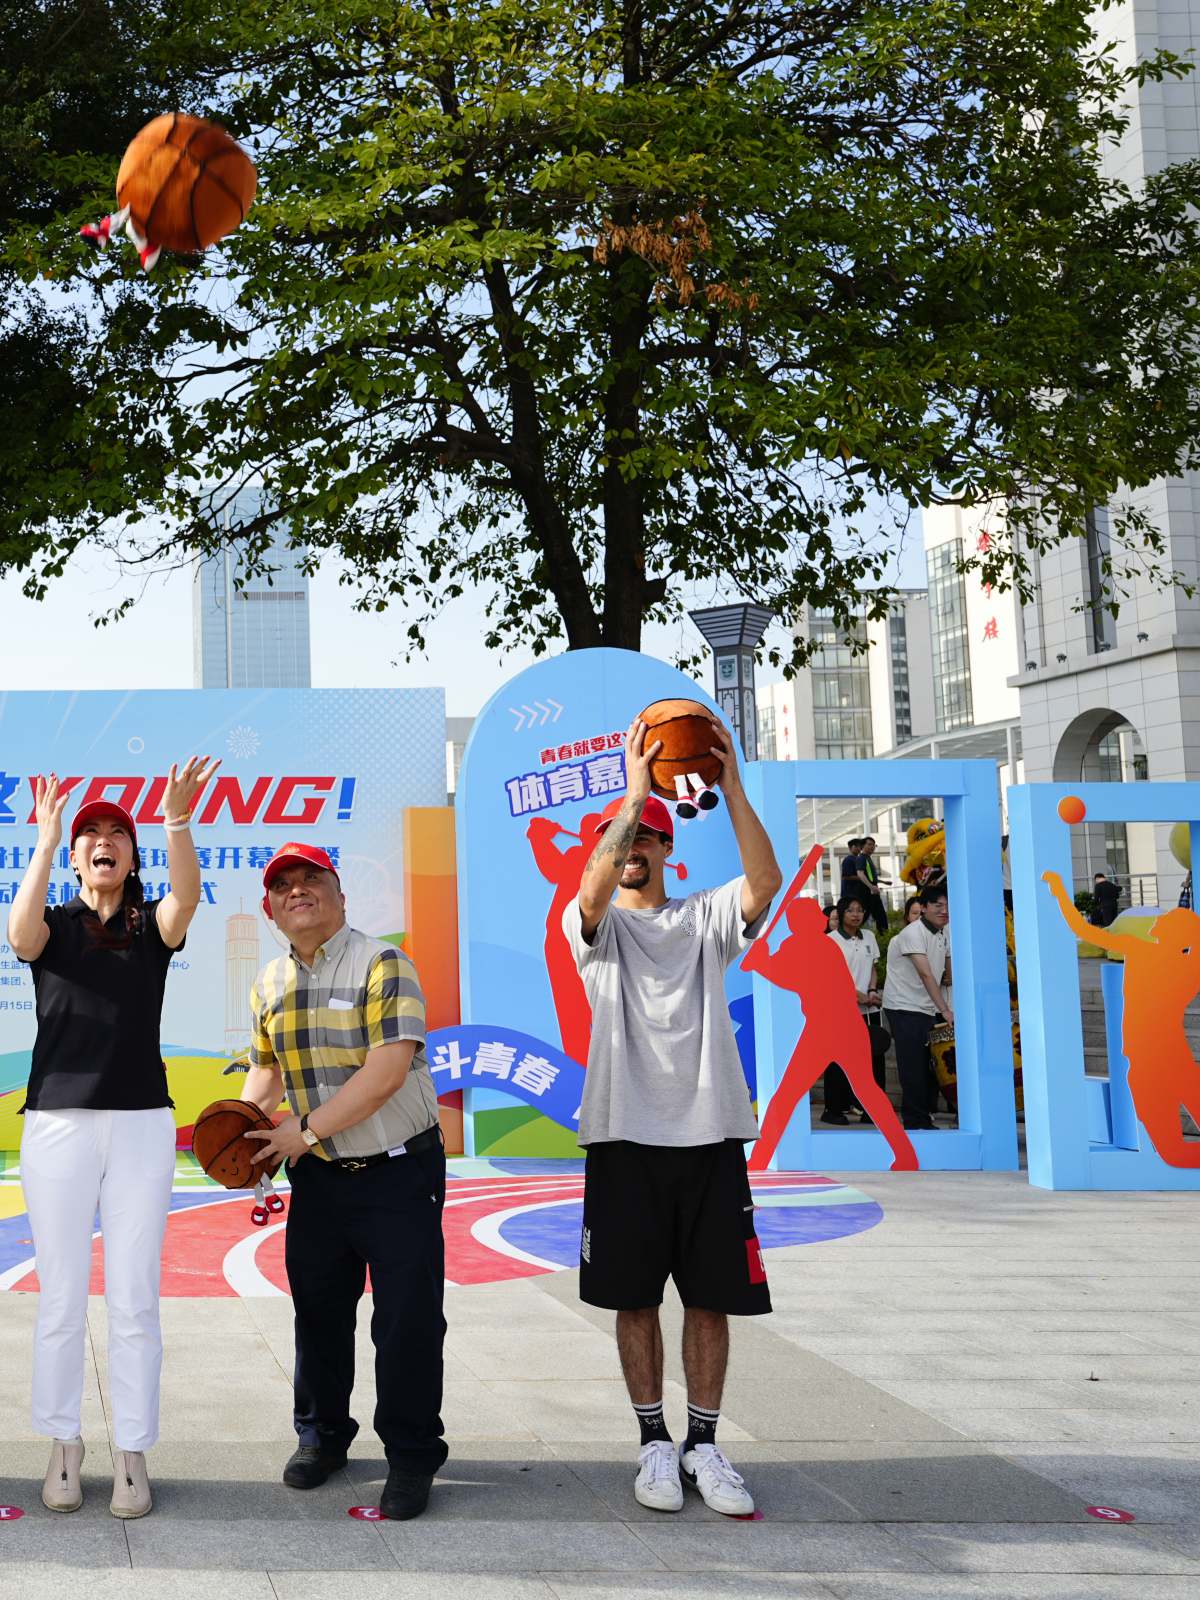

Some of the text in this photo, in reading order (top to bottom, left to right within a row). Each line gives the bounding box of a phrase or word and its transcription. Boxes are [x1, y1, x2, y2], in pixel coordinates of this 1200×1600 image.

[540, 732, 627, 765] 青春就要这
[430, 1040, 561, 1097] 斗青春
